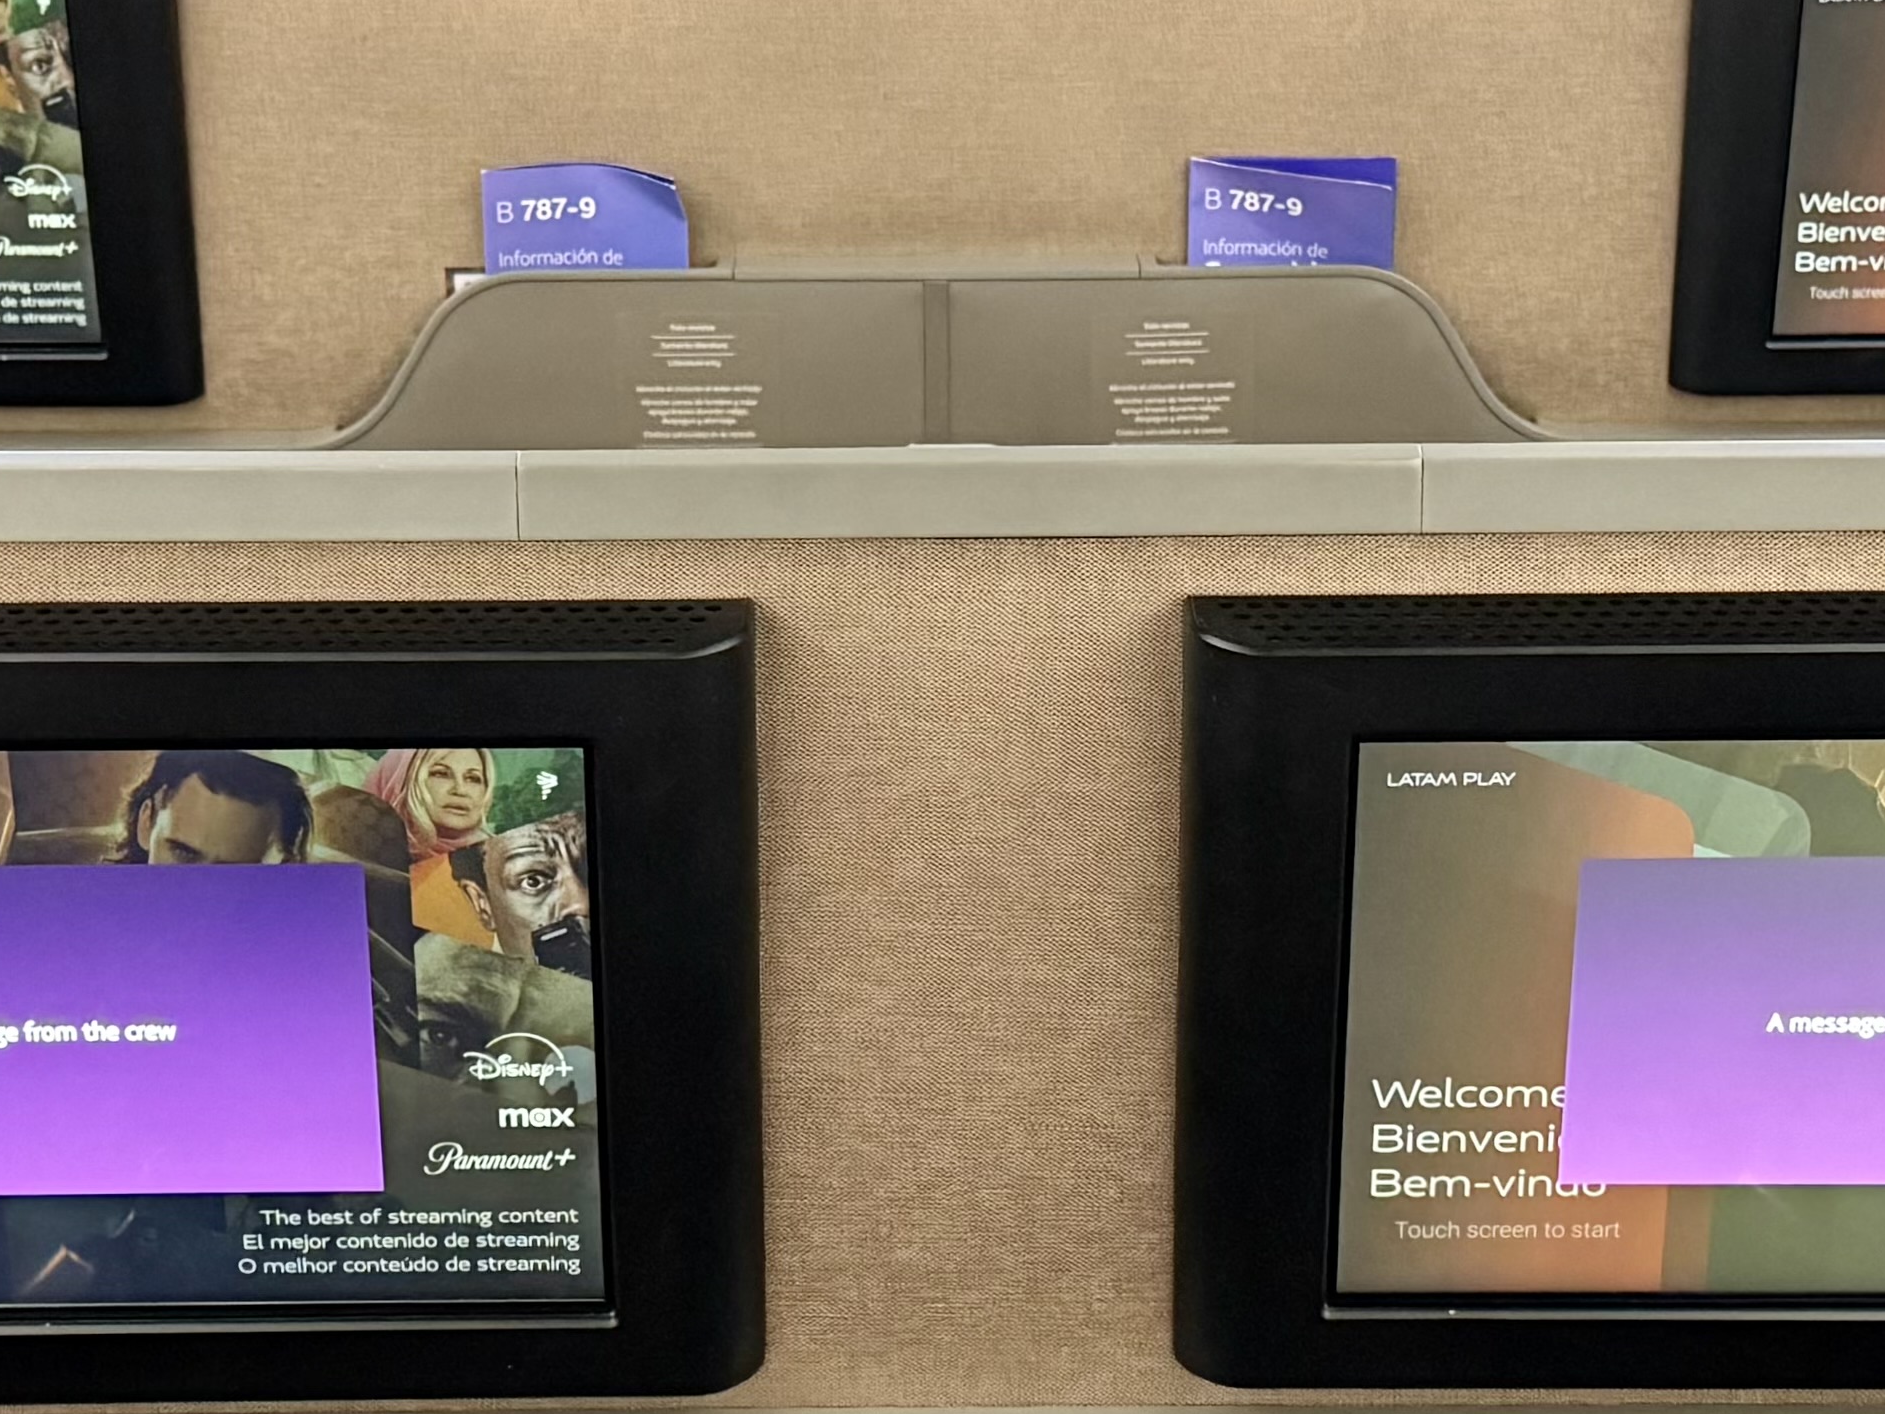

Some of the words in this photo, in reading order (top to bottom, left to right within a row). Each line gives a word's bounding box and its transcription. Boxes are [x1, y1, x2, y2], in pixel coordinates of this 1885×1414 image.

[497, 201, 514, 223] B
[520, 196, 596, 222] 787-9
[1205, 189, 1221, 210] B
[1229, 189, 1303, 216] 787-9
[27, 213, 76, 228] max
[499, 249, 598, 267] Información
[603, 248, 623, 266] de
[1203, 238, 1302, 256] Información
[1307, 243, 1328, 259] de
[1387, 772, 1457, 787] LATAM
[1463, 771, 1516, 786] PLAY
[22, 1019, 78, 1042] from
[80, 1020, 120, 1042] the
[124, 1024, 176, 1041] crew
[1766, 1012, 1784, 1033] A
[1372, 1077, 1566, 1109] Welcome
[498, 1107, 575, 1127] max
[1372, 1123, 1561, 1153] Bienveni
[423, 1142, 576, 1175] Paramount+
[259, 1209, 301, 1225] The
[307, 1209, 353, 1225] best
[359, 1207, 382, 1224] of
[388, 1208, 493, 1228] streaming
[498, 1208, 579, 1223] content
[1395, 1220, 1460, 1239] Touch
[1466, 1224, 1537, 1239] screen
[1544, 1222, 1565, 1238] to
[1571, 1222, 1620, 1238] start
[242, 1233, 264, 1250] El
[270, 1233, 330, 1253] mejor
[336, 1232, 437, 1249] contenido
[443, 1231, 469, 1248] de
[476, 1231, 580, 1251] streaming
[238, 1258, 256, 1274] O
[263, 1256, 337, 1273] melhor
[342, 1256, 439, 1272] conteúdo
[445, 1255, 470, 1271] de
[477, 1255, 581, 1275] streaming
